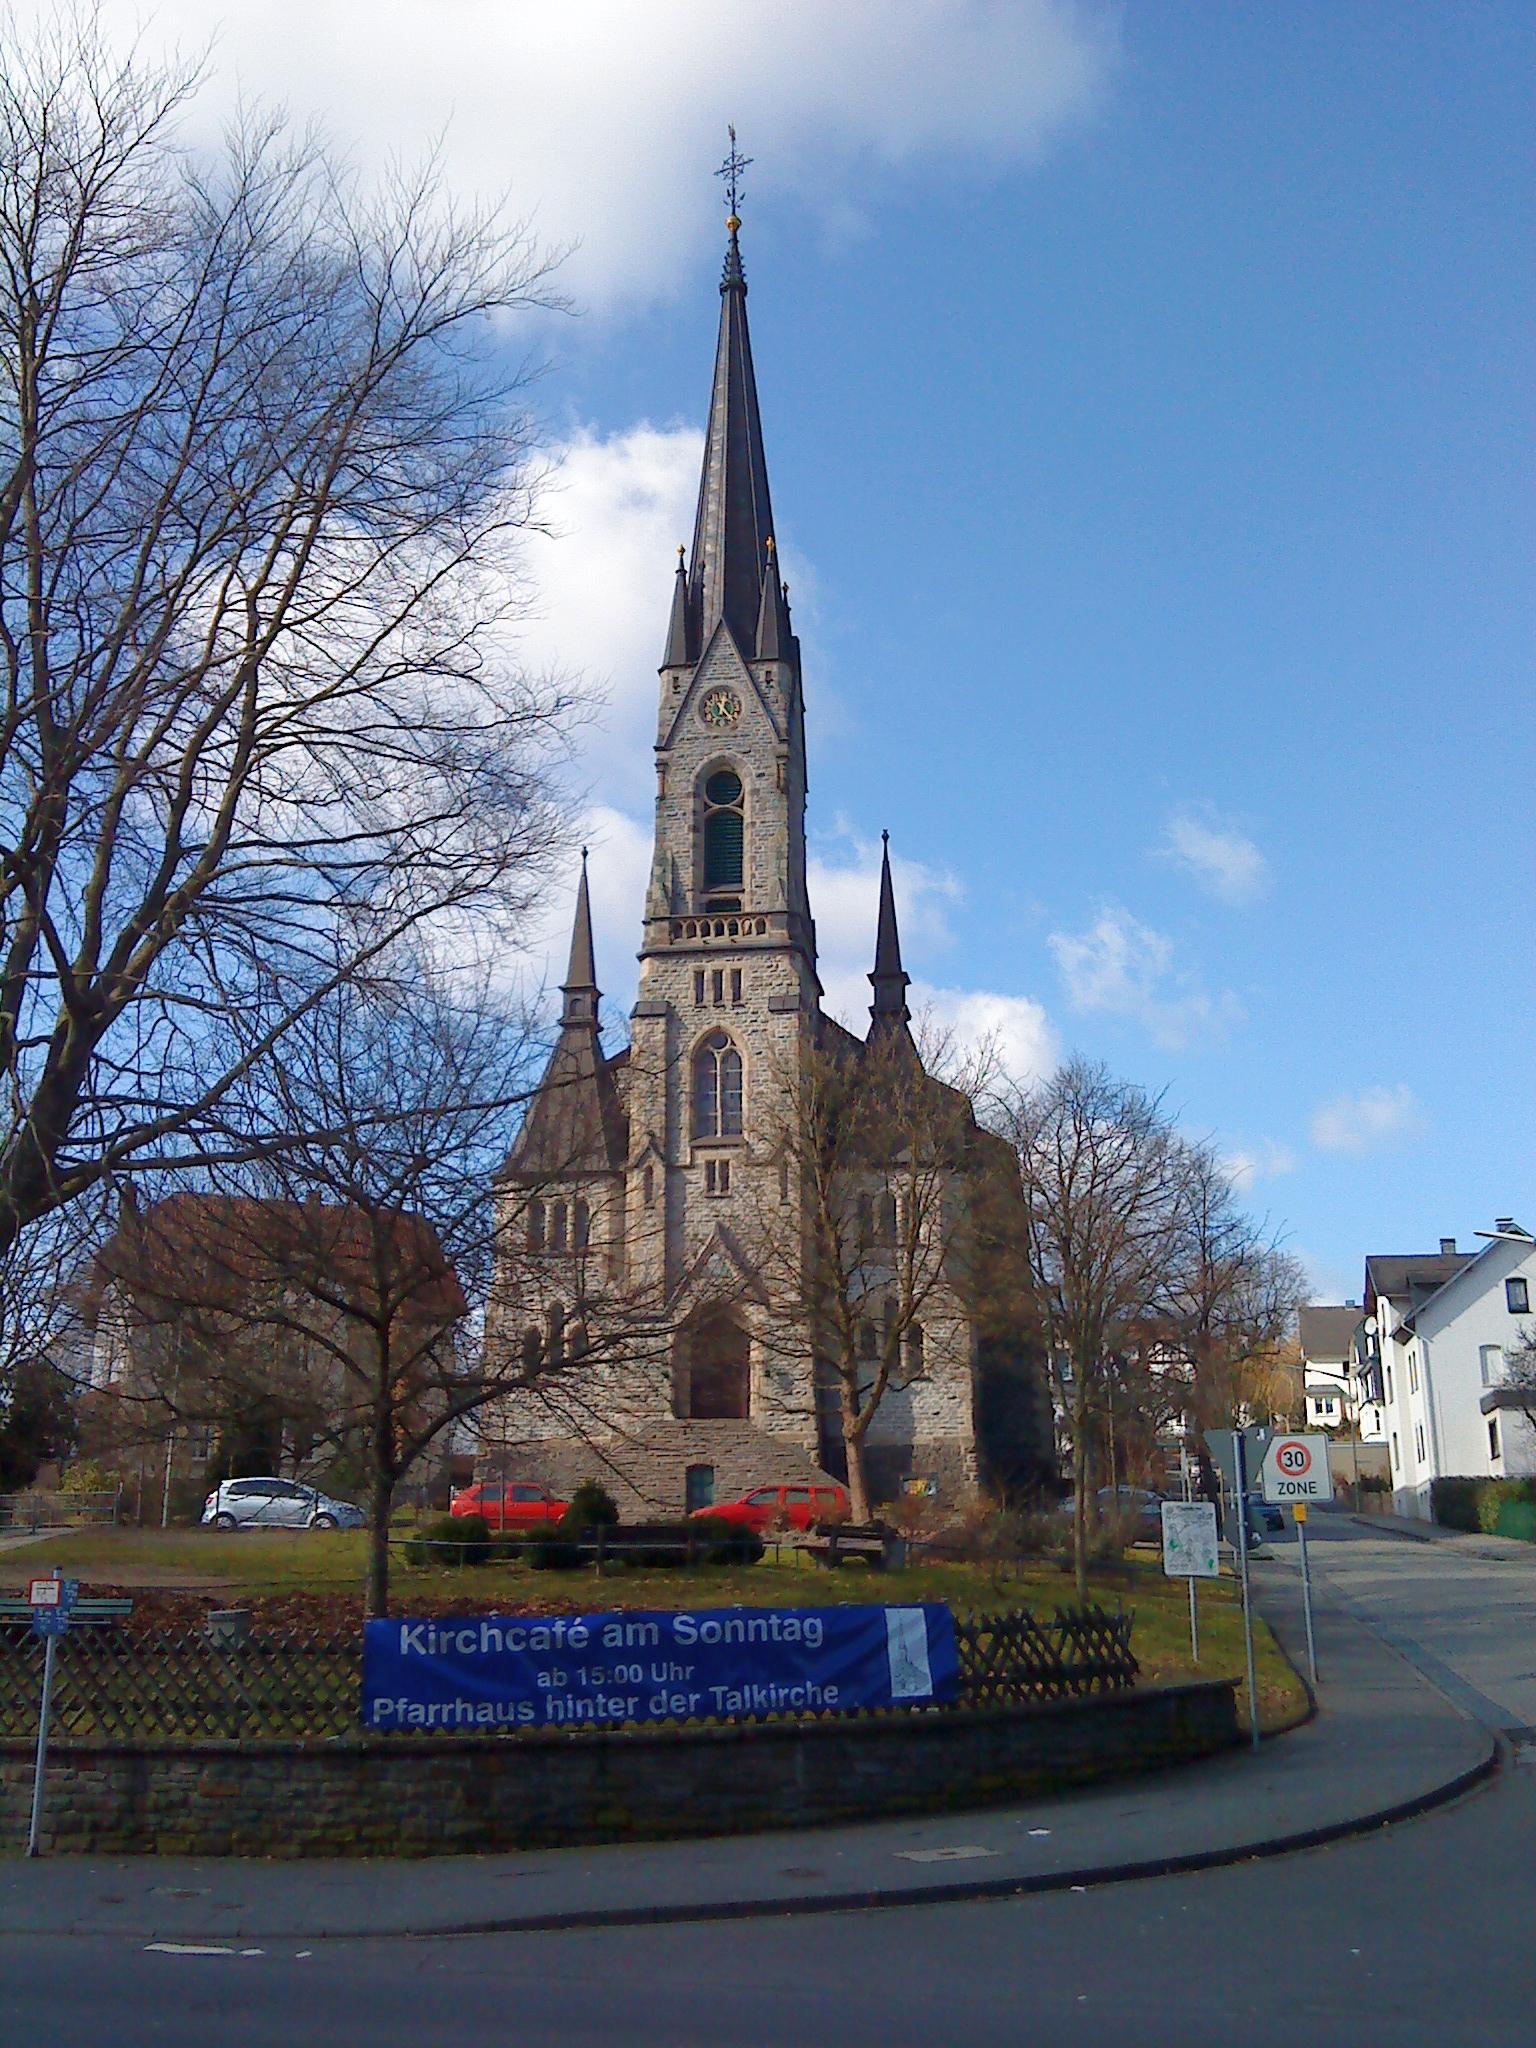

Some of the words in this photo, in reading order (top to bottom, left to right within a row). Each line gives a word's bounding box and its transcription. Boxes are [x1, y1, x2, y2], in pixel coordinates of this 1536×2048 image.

[1283, 1451, 1304, 1468] 30
[1278, 1481, 1317, 1495] ZONE
[400, 1617, 590, 1655] Kirchcafé
[602, 1621, 659, 1648] am
[672, 1614, 824, 1648] Sonntag
[537, 1667, 568, 1688] ab
[577, 1664, 643, 1686] 15:00
[651, 1661, 695, 1683] Uhr
[373, 1697, 536, 1724] Pfarrhaus
[546, 1692, 639, 1721] hinter
[649, 1689, 700, 1715] der
[708, 1680, 839, 1711] Talkirche
